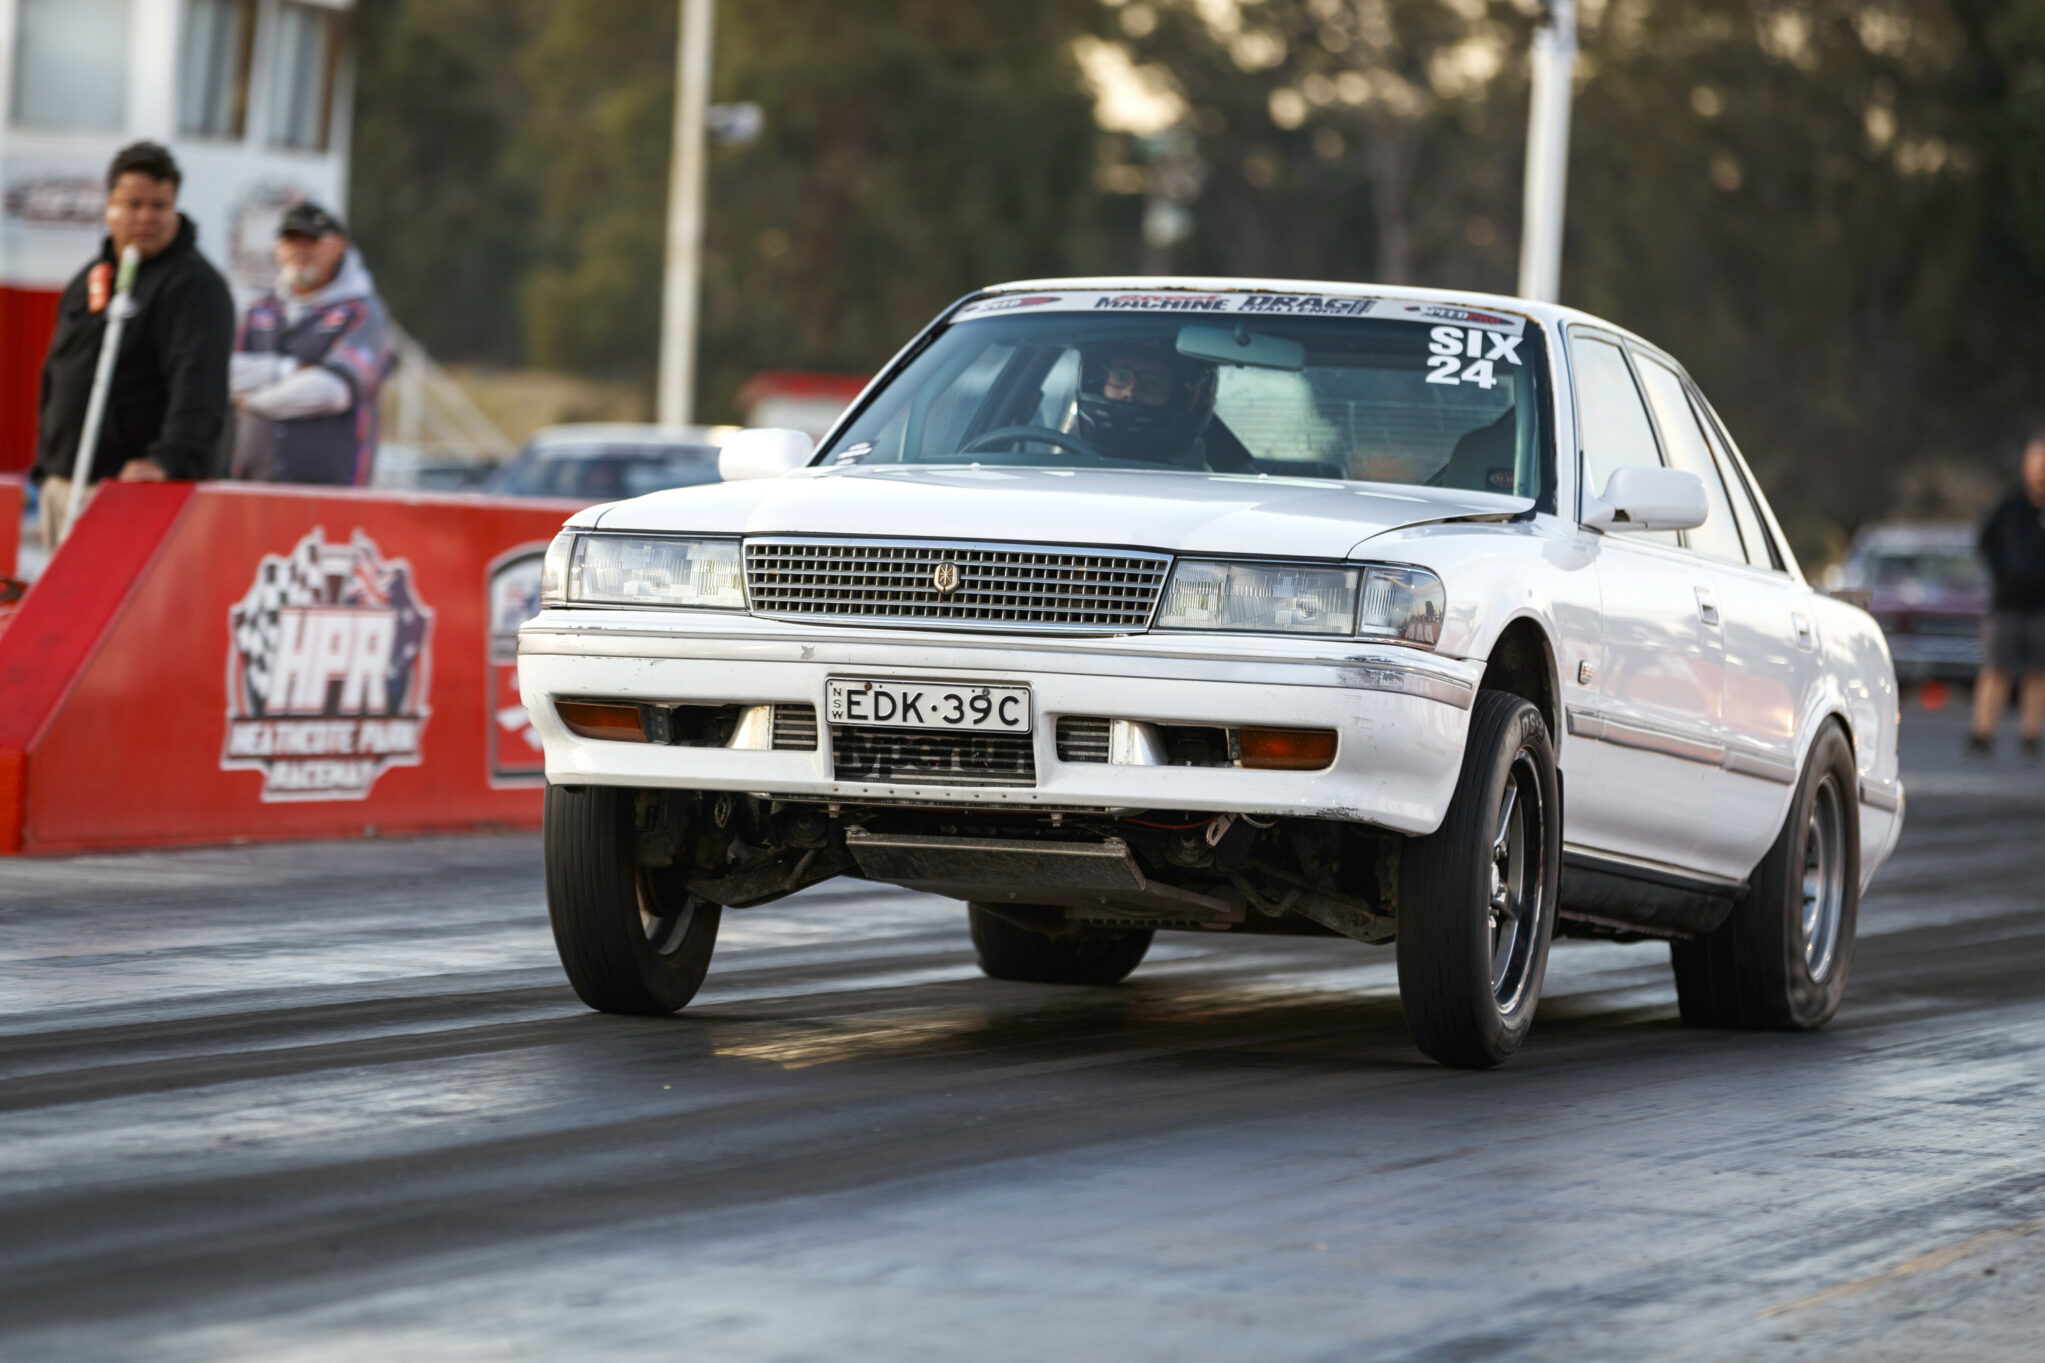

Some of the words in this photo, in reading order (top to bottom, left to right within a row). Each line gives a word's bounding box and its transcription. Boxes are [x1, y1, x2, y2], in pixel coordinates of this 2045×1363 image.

[1094, 297, 1230, 311] MACHINE
[1238, 296, 1352, 311] DRAG
[1428, 325, 1523, 366] SIX
[1425, 355, 1497, 389] 24
[266, 610, 397, 715] HPR
